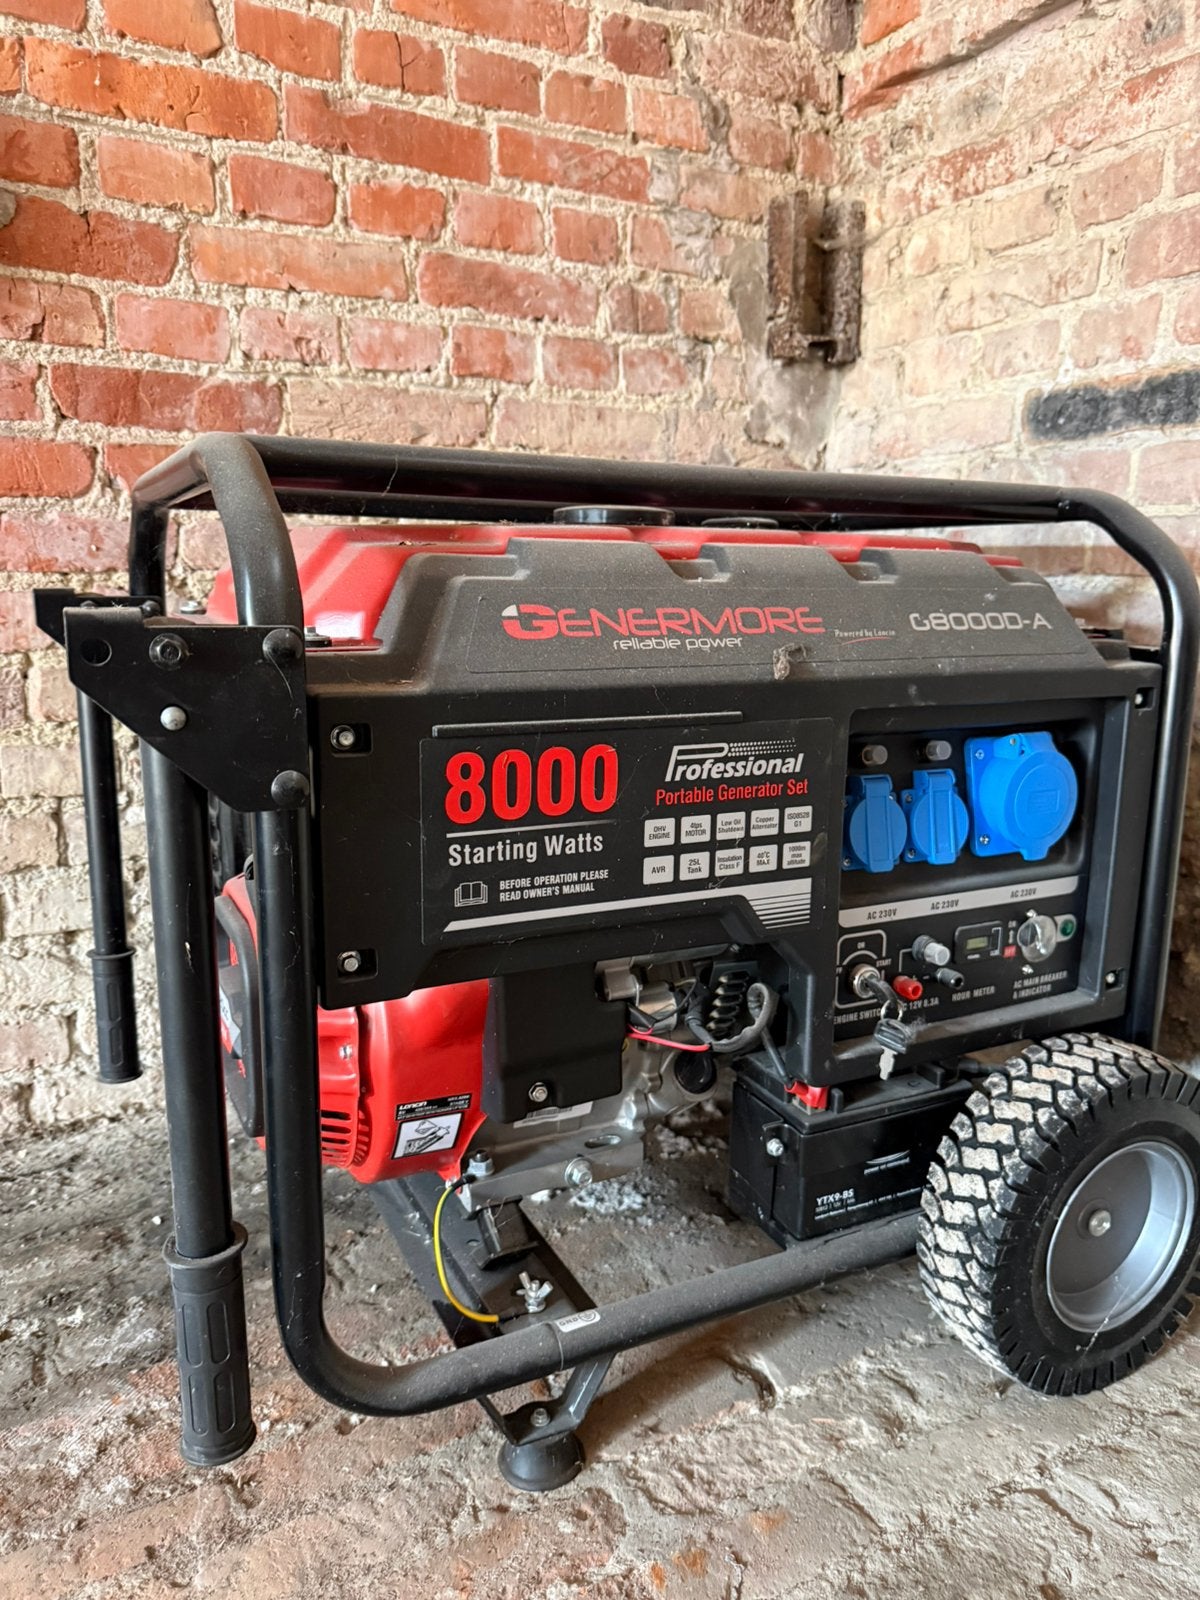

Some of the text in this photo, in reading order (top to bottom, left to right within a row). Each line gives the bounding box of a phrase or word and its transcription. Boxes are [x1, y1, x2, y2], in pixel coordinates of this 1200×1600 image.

[501, 603, 826, 641] GENERMORE
[908, 612, 1053, 631] G8000D-A
[834, 628, 863, 638] Powered
[864, 628, 873, 638] by
[613, 637, 743, 652] reliable power
[664, 742, 804, 782] Professional
[445, 743, 619, 824] 8000
[655, 778, 808, 806] Portable Generator Set
[733, 818, 742, 826] Oil
[755, 816, 775, 824] Copper
[653, 825, 667, 833] OHV
[685, 829, 707, 838] MOTOR
[648, 832, 671, 840] ENGINE
[448, 832, 604, 867] Starting Watts
[688, 858, 702, 866] 25L
[719, 863, 735, 871] Class
[651, 865, 666, 874] AVR
[688, 866, 702, 874] Tank
[499, 869, 609, 891] BEFORE OPERATION PLEASE
[499, 882, 595, 902] READ OWNER'S MANUAL
[1010, 887, 1037, 898] AC 230V
[931, 899, 959, 910] AC 230V
[867, 908, 897, 920] AC 230V
[951, 985, 995, 1002] HOUR METER
[909, 1000, 922, 1010] 12V
[859, 1007, 882, 1020] SWITC
[816, 1188, 855, 1206] YTX9-BS
